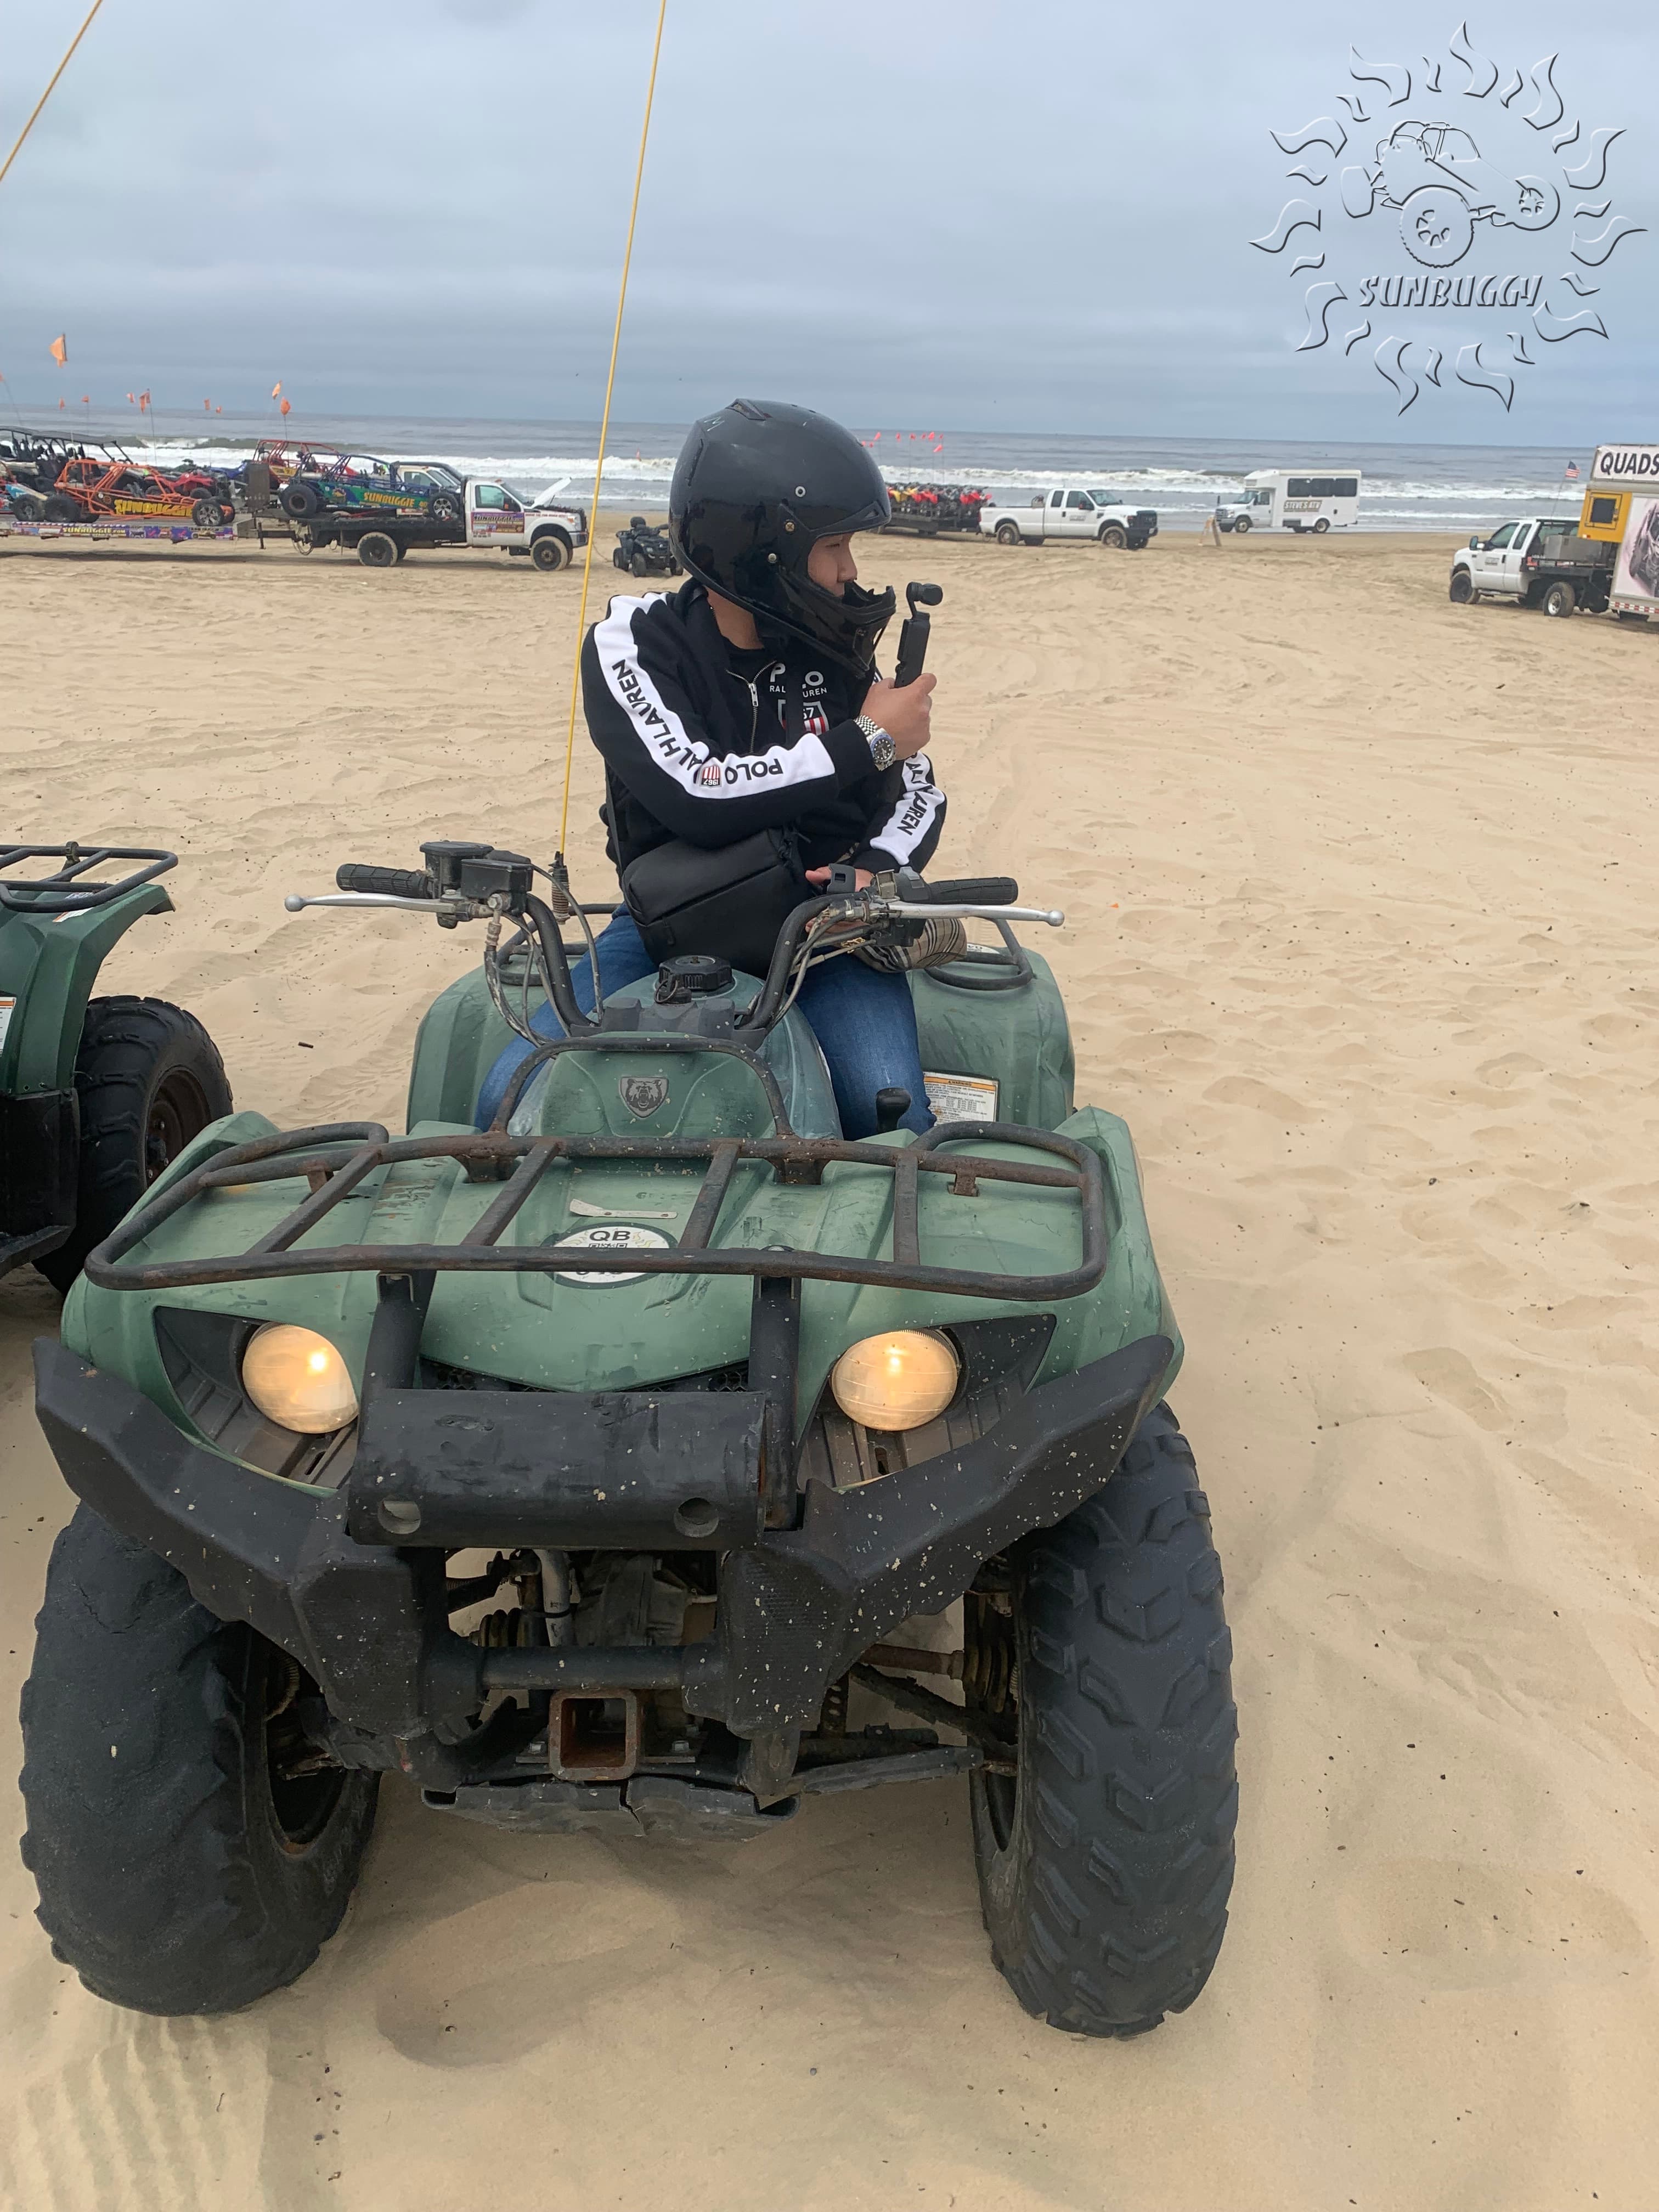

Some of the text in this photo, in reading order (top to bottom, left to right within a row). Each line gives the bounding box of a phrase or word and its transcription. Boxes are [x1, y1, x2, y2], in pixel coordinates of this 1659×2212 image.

[1600, 452, 1659, 475] QUADS
[770, 663, 823, 686] PO
[803, 687, 827, 698] UREN
[725, 758, 783, 785] POLO
[589, 1231, 631, 1241] QB
